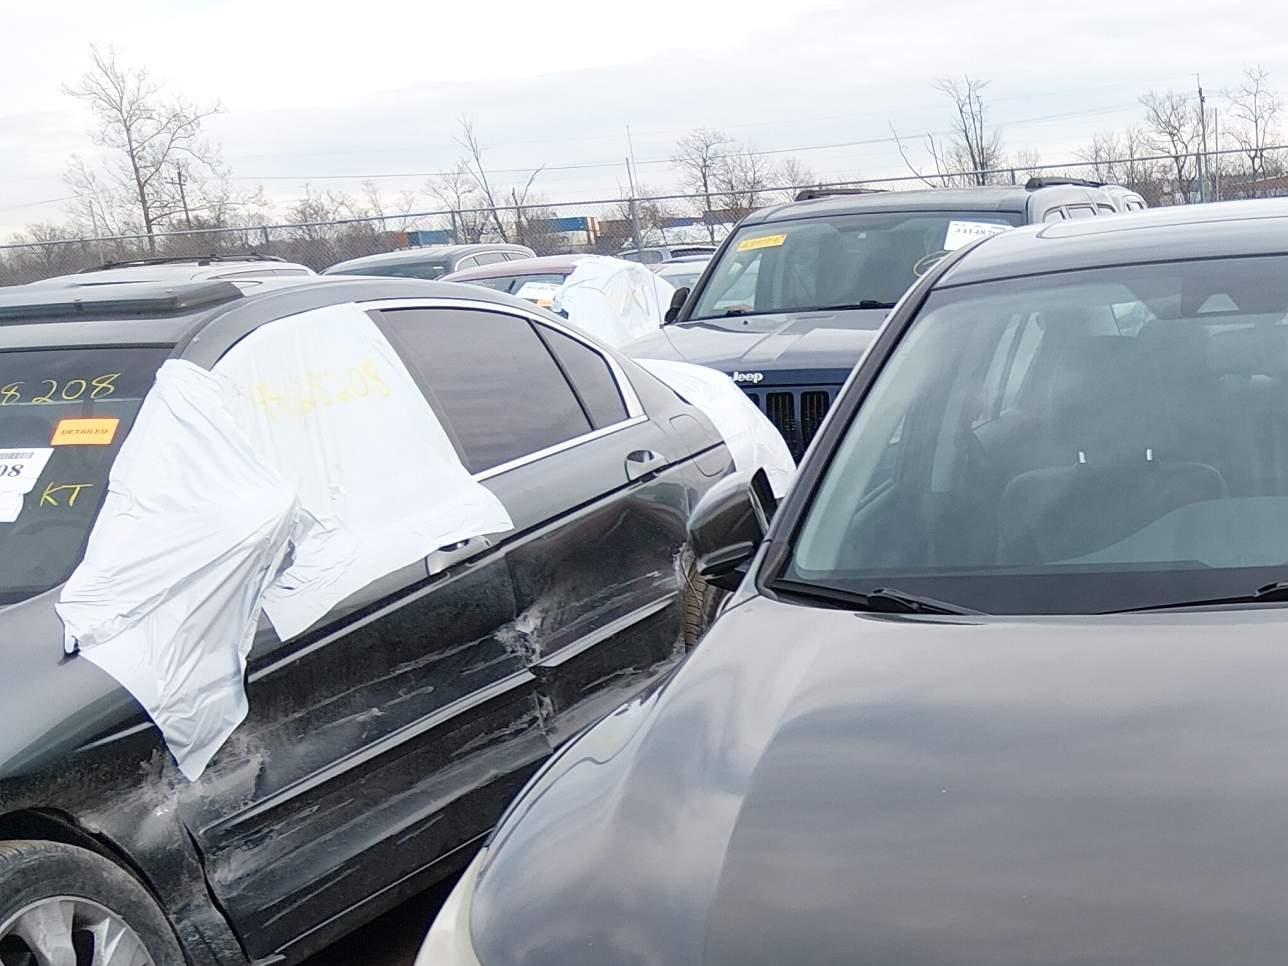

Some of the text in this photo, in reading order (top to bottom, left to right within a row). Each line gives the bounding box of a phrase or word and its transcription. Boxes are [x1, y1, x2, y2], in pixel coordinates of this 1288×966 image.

[733, 371, 764, 384] Jeep
[61, 428, 109, 436] DETAILED
[39, 481, 95, 508] KT
